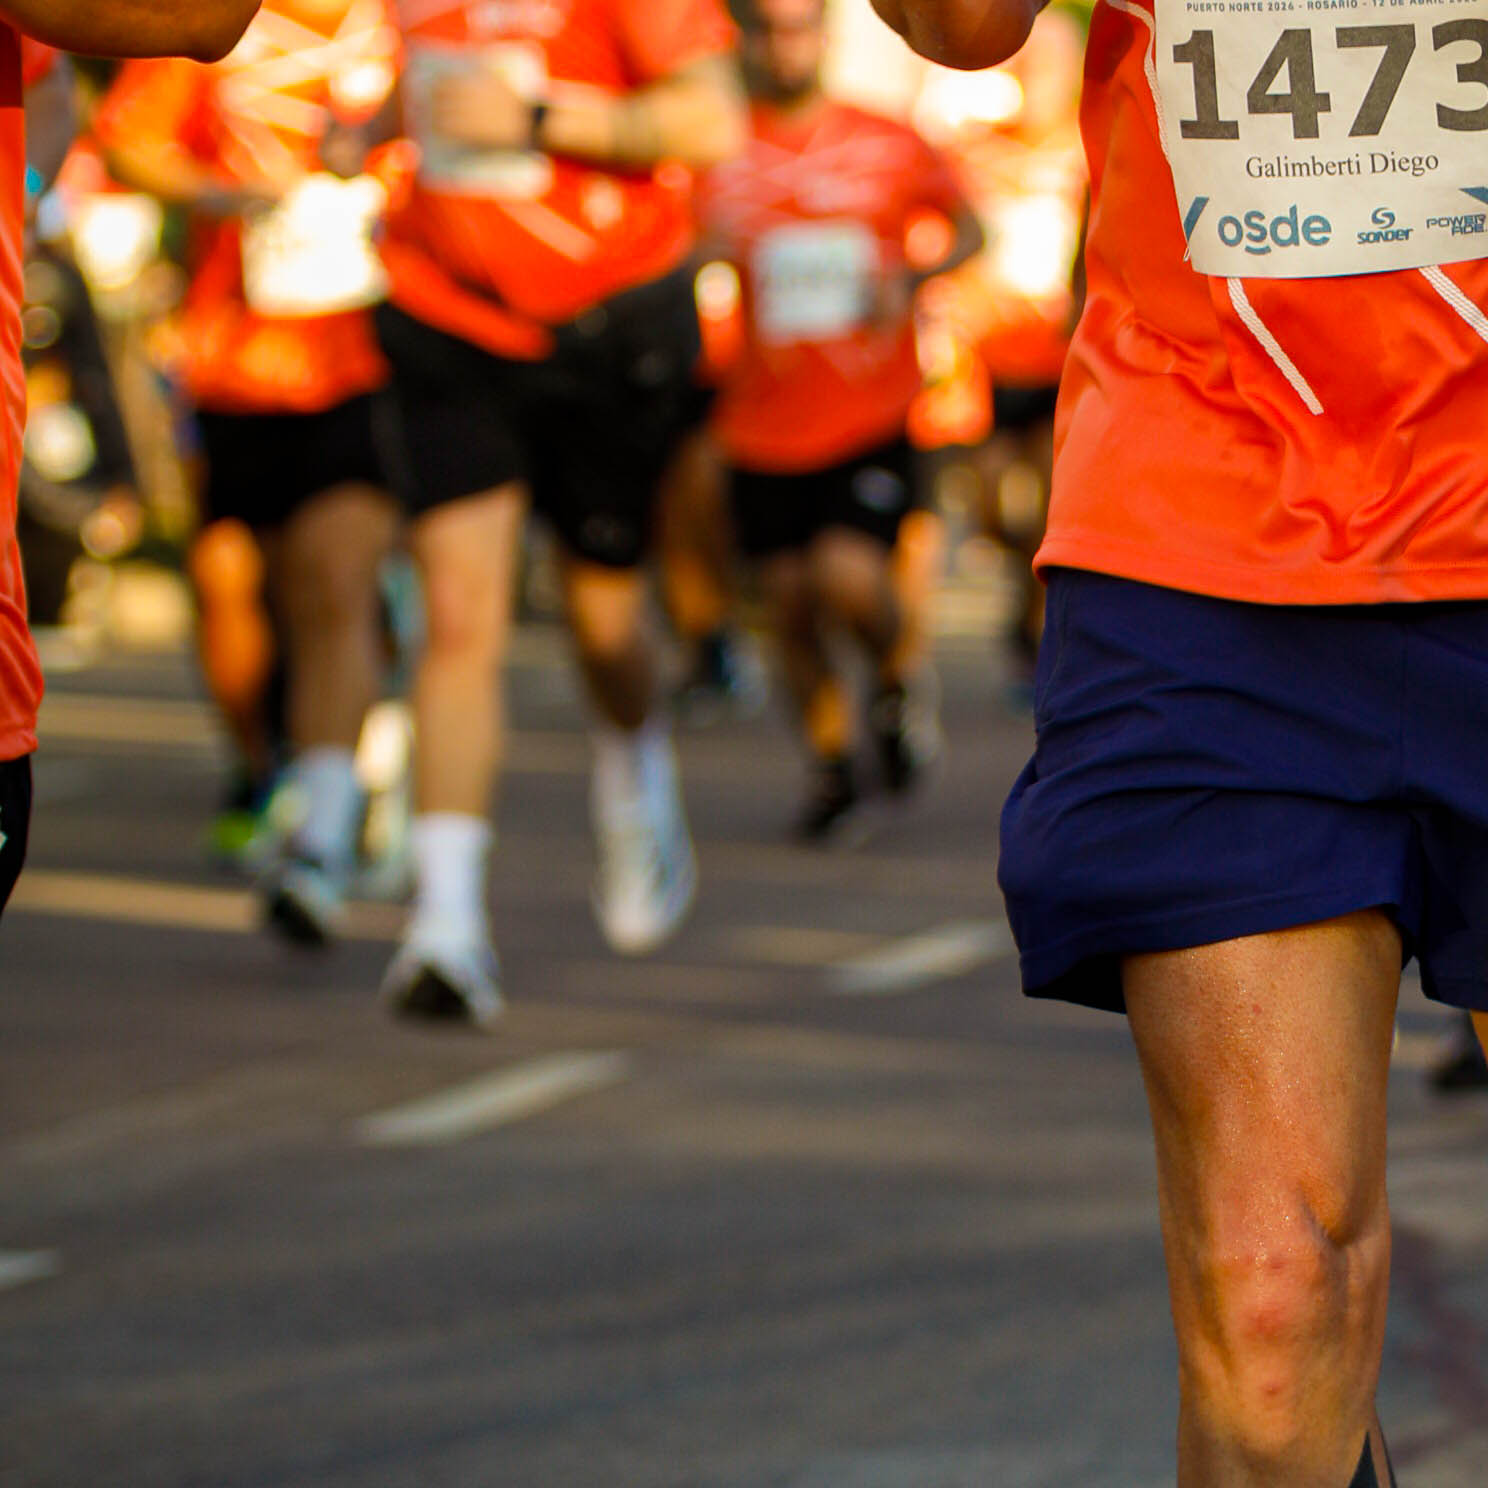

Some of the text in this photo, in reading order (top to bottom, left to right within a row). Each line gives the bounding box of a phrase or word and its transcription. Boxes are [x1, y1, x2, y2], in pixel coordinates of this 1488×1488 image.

[1187, 1, 1225, 13] PUERTO
[1229, 1, 1263, 12] NORTE
[1307, 0, 1358, 10] ROSARIO
[1245, 152, 1439, 179] Galimberti Diego
[1217, 204, 1332, 250] osde
